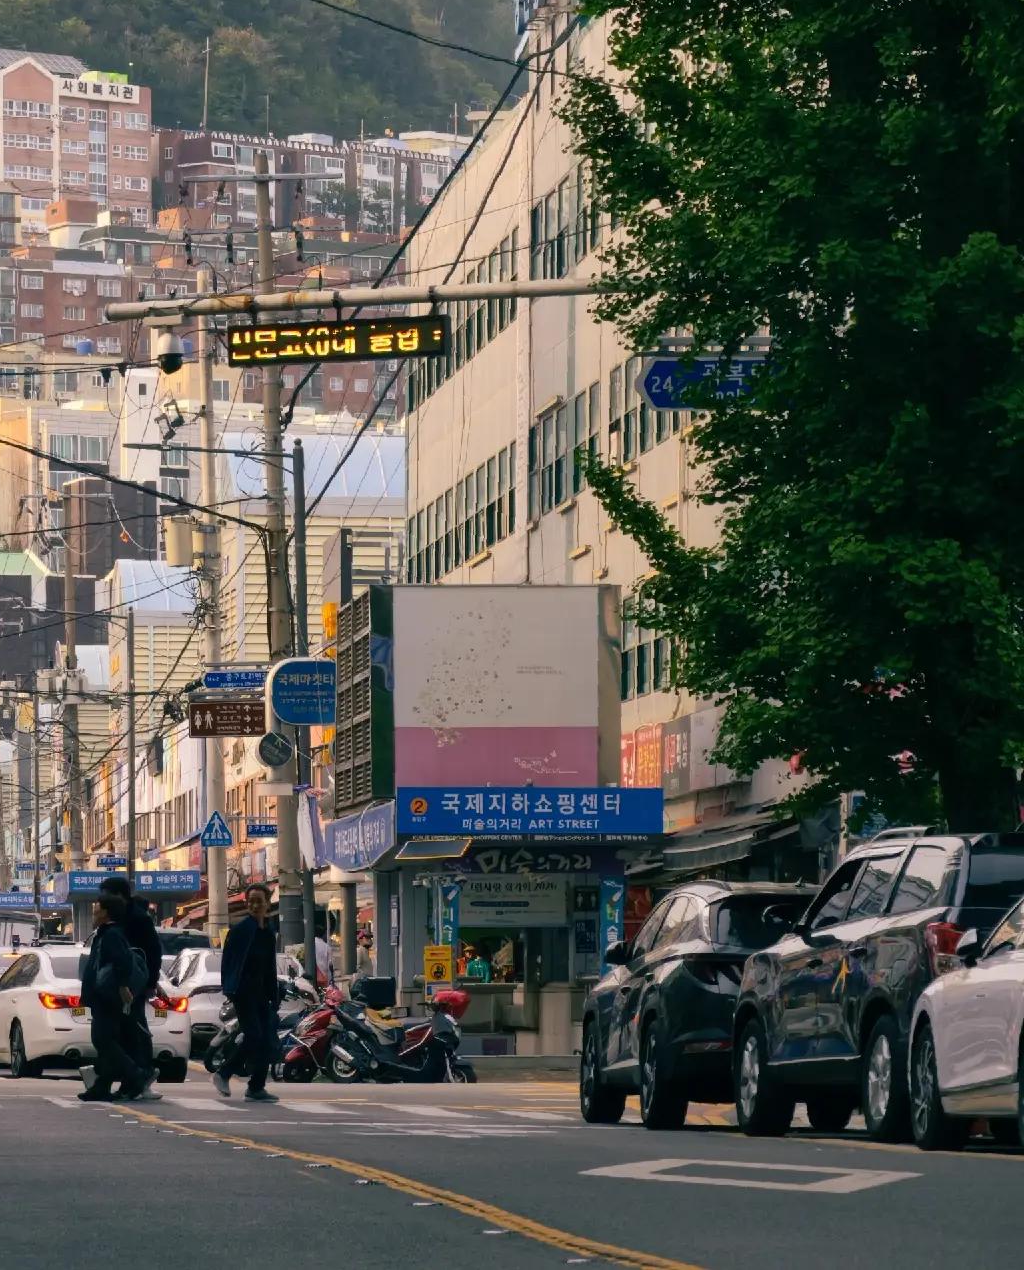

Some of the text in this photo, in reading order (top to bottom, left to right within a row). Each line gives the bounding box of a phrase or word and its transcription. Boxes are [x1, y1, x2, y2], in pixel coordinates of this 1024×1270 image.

[61, 80, 133, 100] 사회복지관
[414, 800, 423, 813] 2
[440, 793, 622, 815] 국제지하쇼핑센터
[462, 819, 600, 830] 미술의거리 ART STREET
